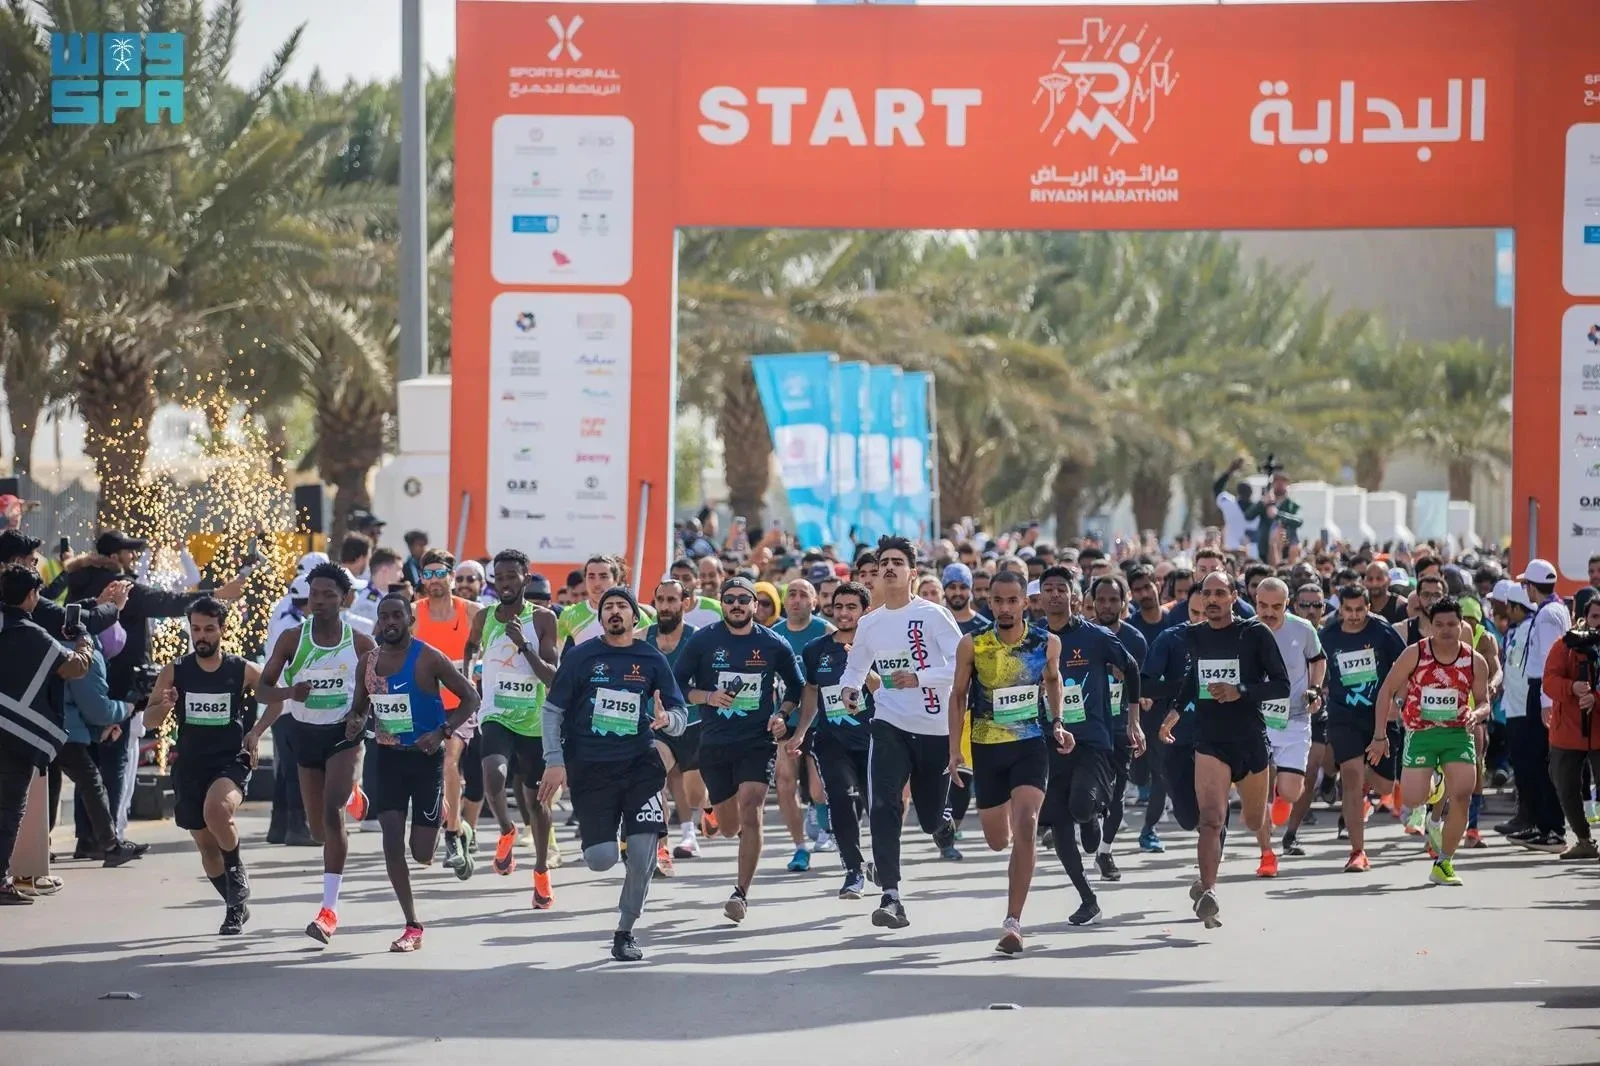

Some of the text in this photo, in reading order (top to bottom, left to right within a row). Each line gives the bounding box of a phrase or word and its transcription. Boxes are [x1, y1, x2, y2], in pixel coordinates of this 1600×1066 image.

[509, 68, 620, 79] SPORTS FOR ALL
[697, 86, 982, 146] START
[1250, 78, 1486, 164] البداية
[1031, 165, 1098, 187] الرياض
[1031, 189, 1179, 203] RIYADH MARATHON
[908, 620, 928, 661] ECKO
[878, 658, 910, 670] 12672
[1342, 658, 1371, 669] 13713
[1200, 669, 1237, 679] 13473
[498, 680, 533, 693] 14310
[998, 691, 1035, 705] 11886
[1423, 695, 1456, 705] 10369
[189, 702, 227, 712] 12682
[601, 699, 637, 713] 12159
[636, 810, 664, 823] adid
